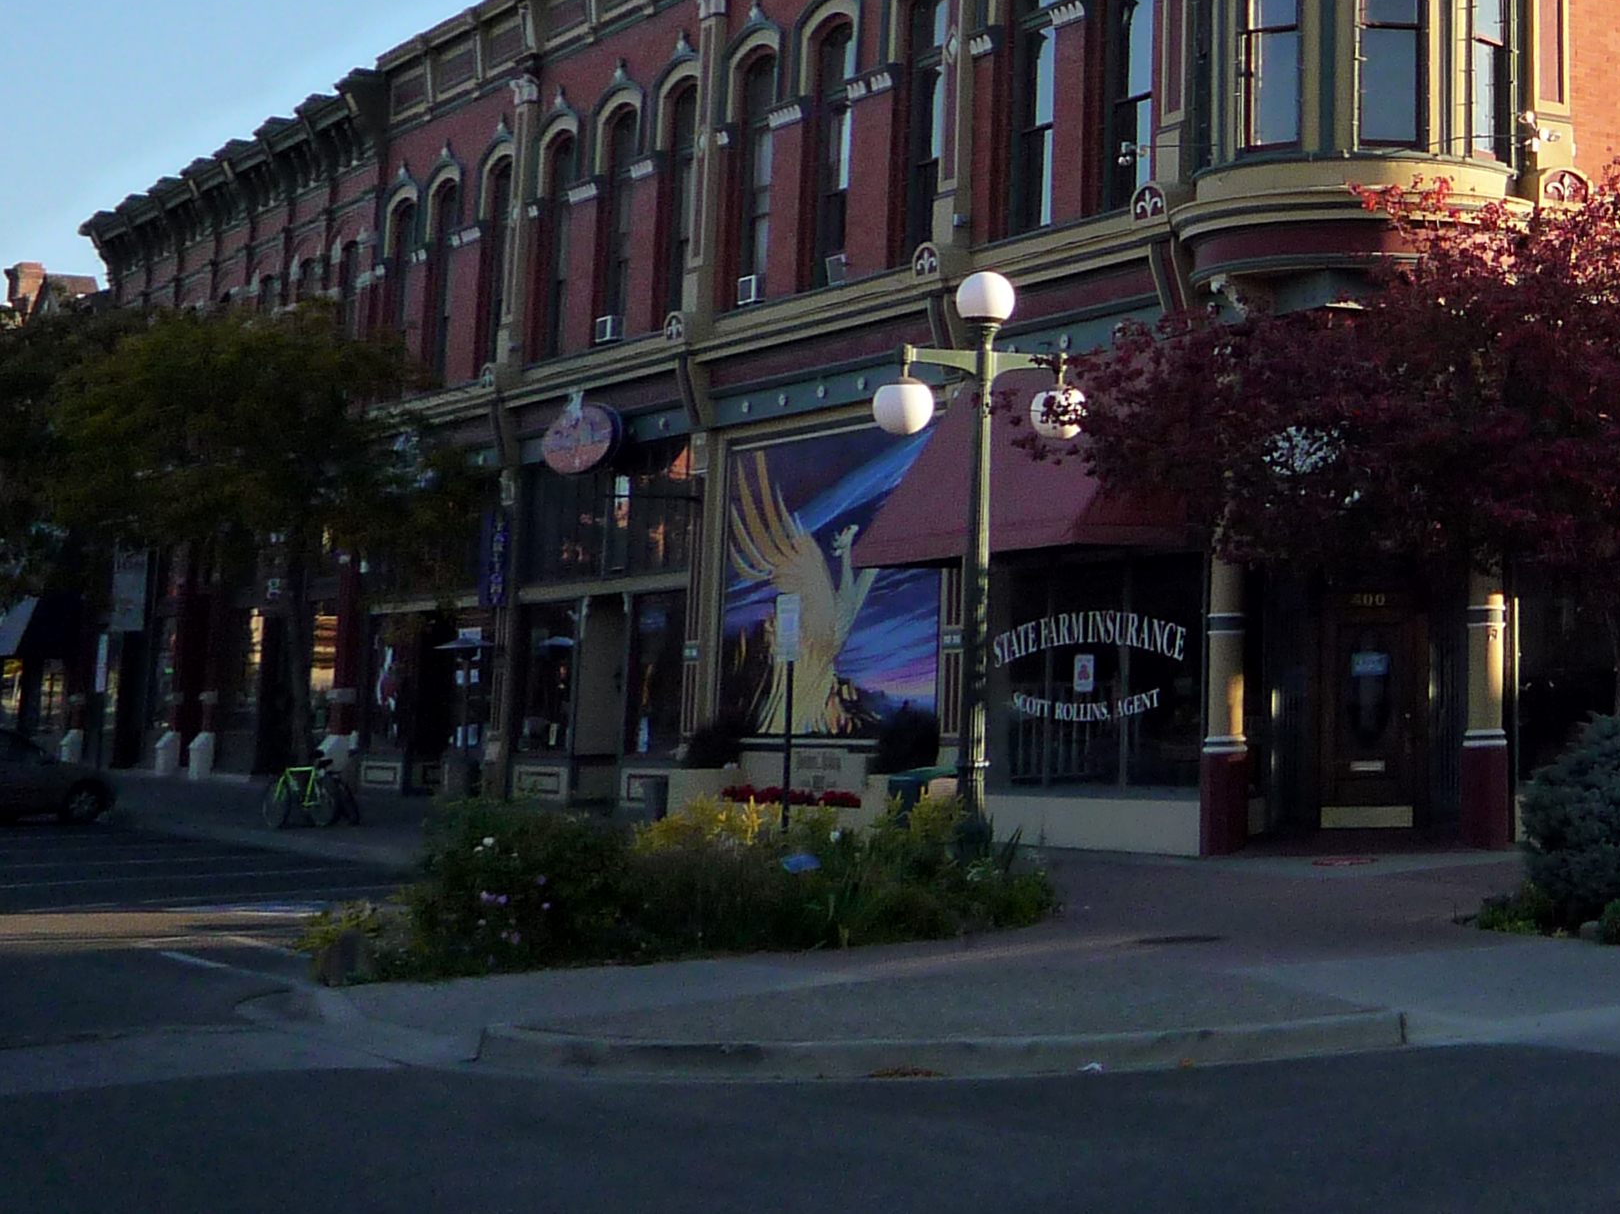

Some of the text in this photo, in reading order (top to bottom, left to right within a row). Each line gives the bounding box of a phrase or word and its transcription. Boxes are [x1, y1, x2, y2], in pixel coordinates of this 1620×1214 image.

[1350, 593, 1385, 606] 400
[993, 609, 1185, 667] STATE FARM INSURANCE
[1012, 687, 1160, 720] SCOTT ROLLINS, AGENT
